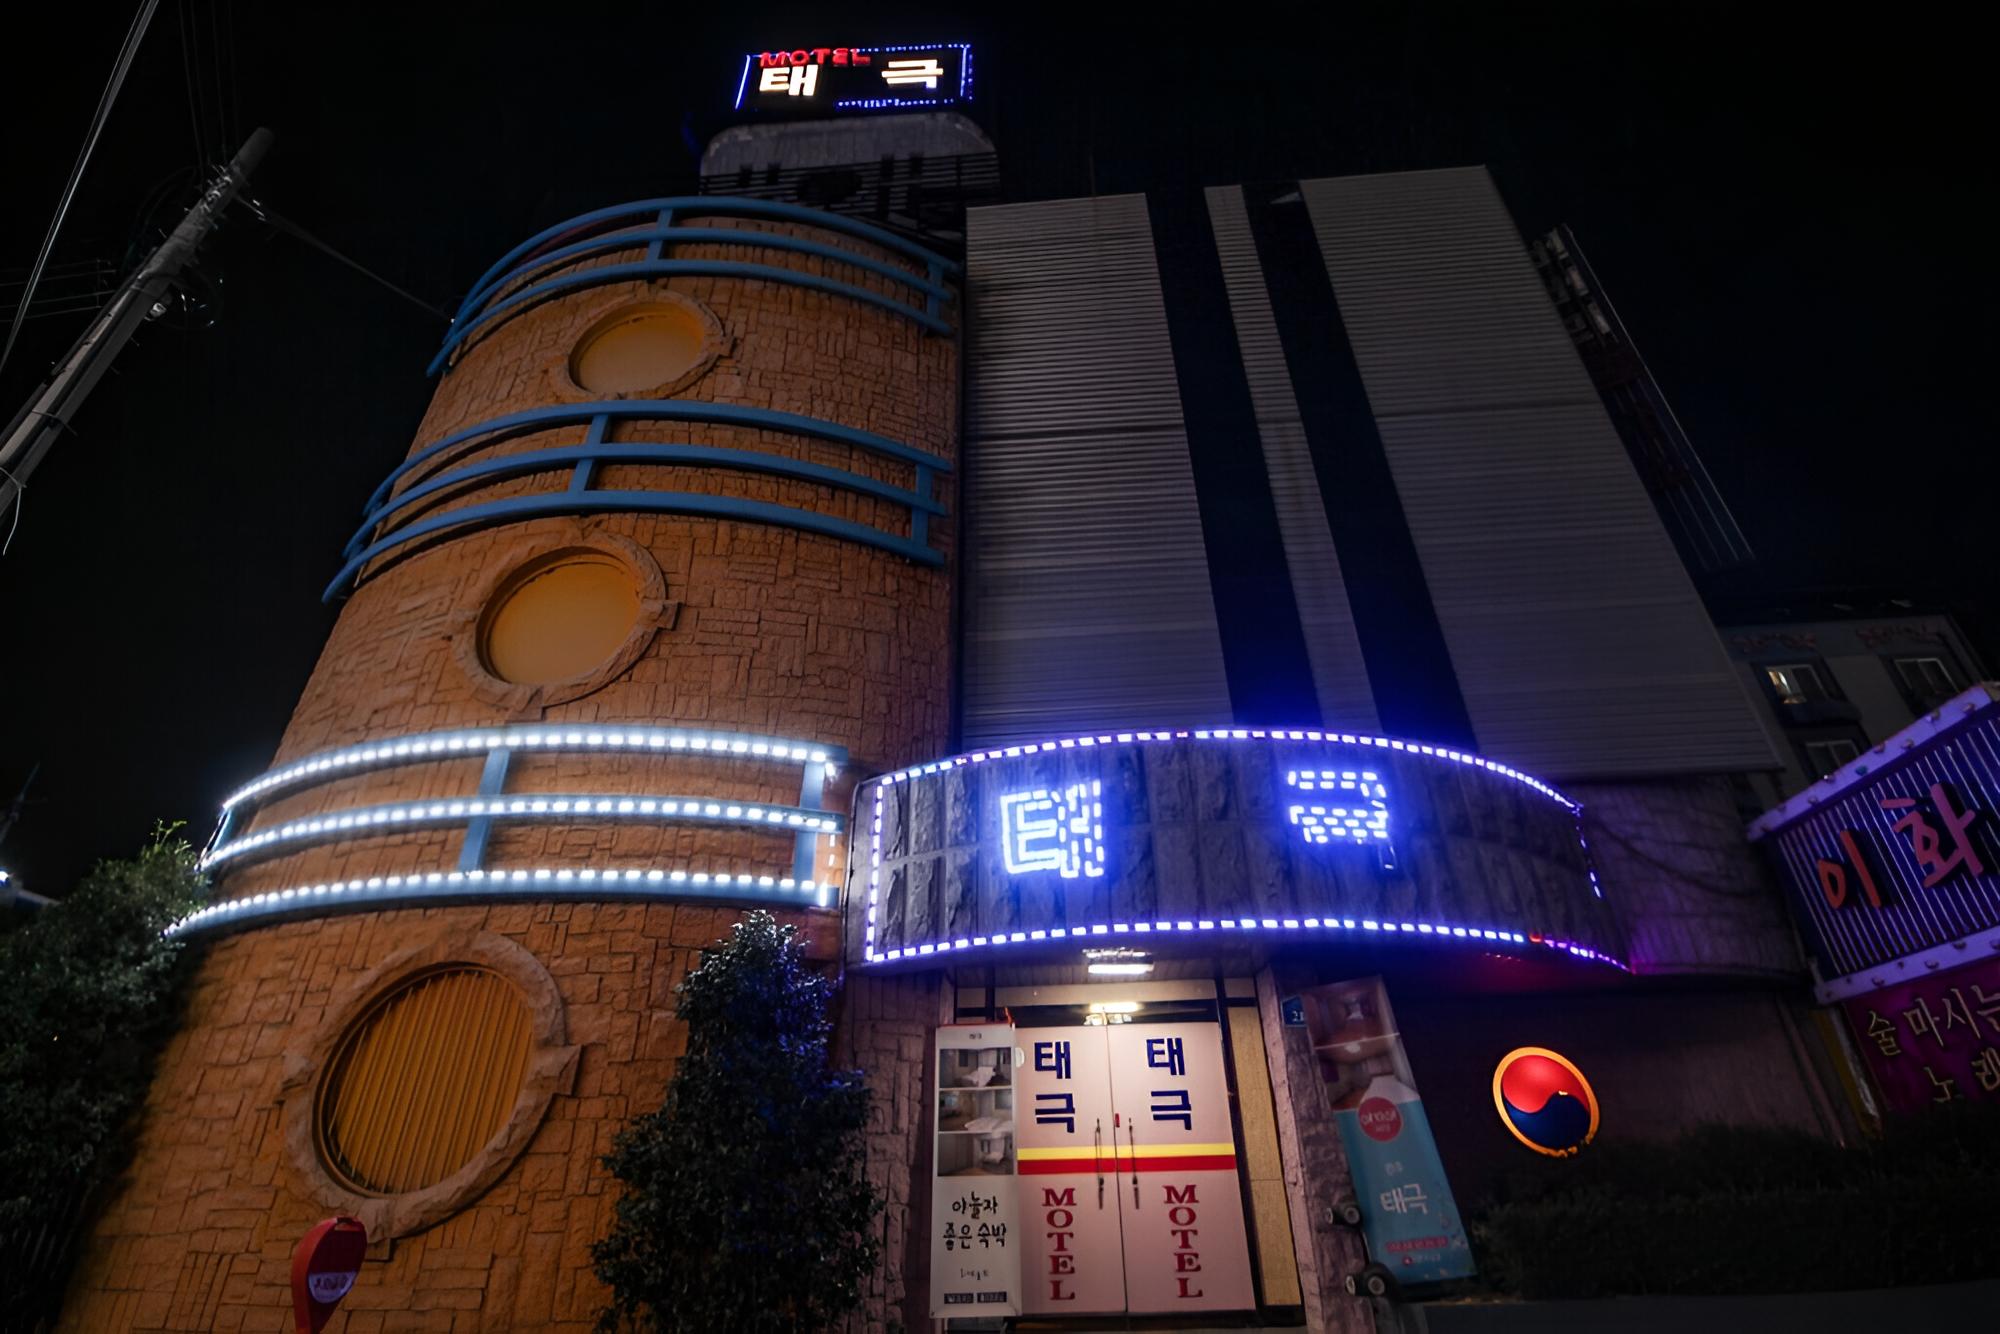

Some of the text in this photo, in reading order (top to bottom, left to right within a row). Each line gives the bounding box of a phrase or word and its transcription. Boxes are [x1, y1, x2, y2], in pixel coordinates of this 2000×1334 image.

[759, 46, 872, 67] MOTEL
[1867, 1010, 1902, 1056] 술
[1380, 1184, 1428, 1215] 태극
[943, 1222, 1007, 1251] 좋은 숙박
[1042, 1187, 1077, 1300] MOTEL
[1163, 1184, 1203, 1298] MOTEL
